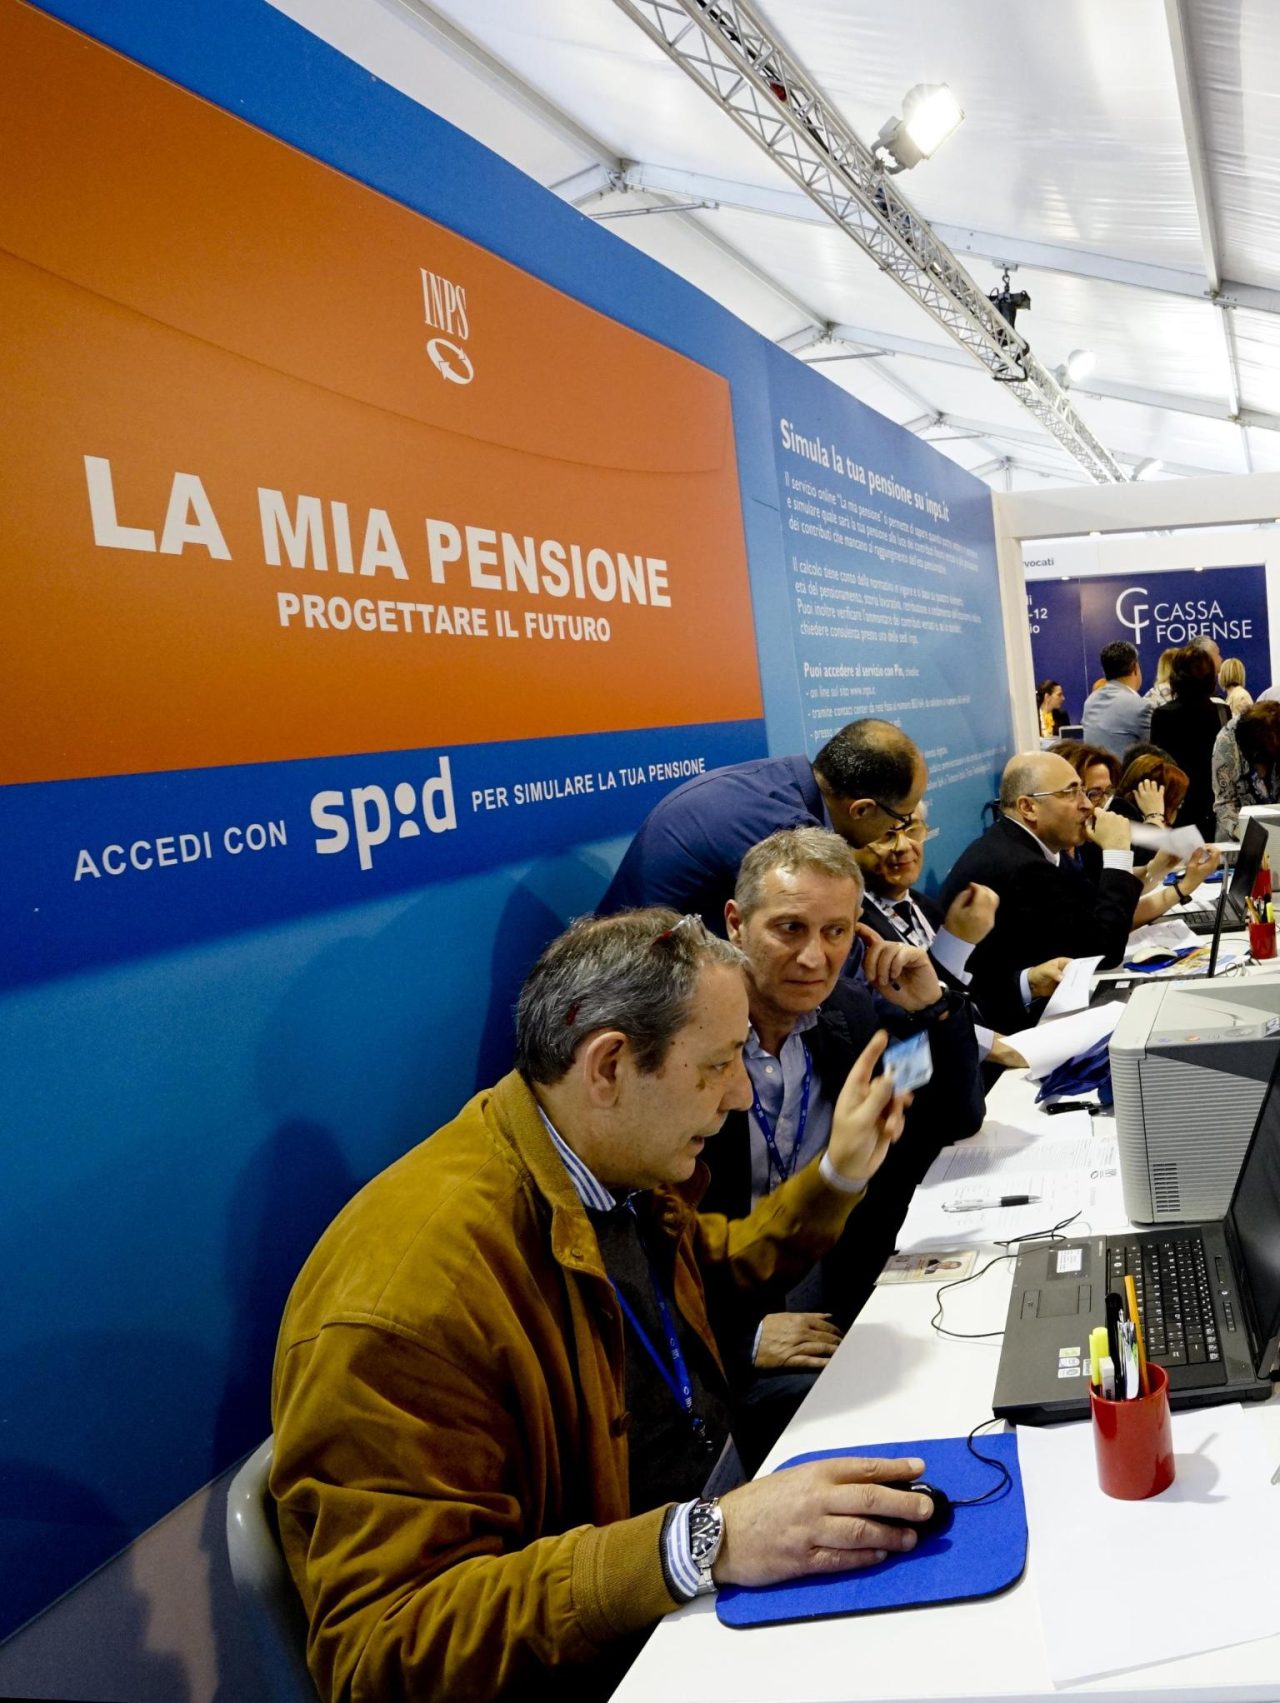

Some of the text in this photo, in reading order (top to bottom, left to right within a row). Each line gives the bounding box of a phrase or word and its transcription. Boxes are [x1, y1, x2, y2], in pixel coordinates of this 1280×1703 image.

[420, 267, 469, 339] INPS
[780, 418, 950, 522] Simula la tua pensione su inps.it
[792, 479, 817, 497] servizio
[84, 454, 672, 608] LA MIA PENSIONE
[793, 500, 820, 518] simulare
[821, 510, 838, 524] quale
[866, 526, 888, 541] pensione
[789, 515, 800, 531] dei
[801, 523, 833, 541] contributi
[833, 533, 843, 544] che
[844, 536, 868, 552] mancano
[793, 557, 798, 571] Il
[800, 561, 823, 576] calcolo
[840, 572, 857, 584] conto
[1024, 557, 1054, 568] vocati
[795, 582, 806, 593] età
[808, 581, 818, 595] del
[276, 592, 611, 643] PROGETTARE IL FUTURO
[797, 598, 813, 614] Puoi
[815, 603, 836, 618] inoltre
[836, 606, 863, 621] verificare
[1028, 607, 1049, 620] -12
[1154, 600, 1224, 622] CASSA
[801, 622, 829, 636] chiedere
[830, 627, 860, 639] consulenza
[861, 630, 877, 641] presso
[1156, 619, 1253, 643] FORENSE
[804, 662, 822, 677] Puoi
[824, 664, 854, 677] accedere
[855, 664, 861, 676] al
[862, 665, 884, 676] servizio
[884, 668, 894, 676] con
[73, 836, 213, 882] ACCEDI
[223, 819, 288, 856] CON
[471, 786, 509, 813] PER
[514, 773, 595, 807] SIMULARE
[599, 770, 617, 790] LA
[620, 764, 646, 788] TUA
[649, 756, 706, 783] PENSIONE
